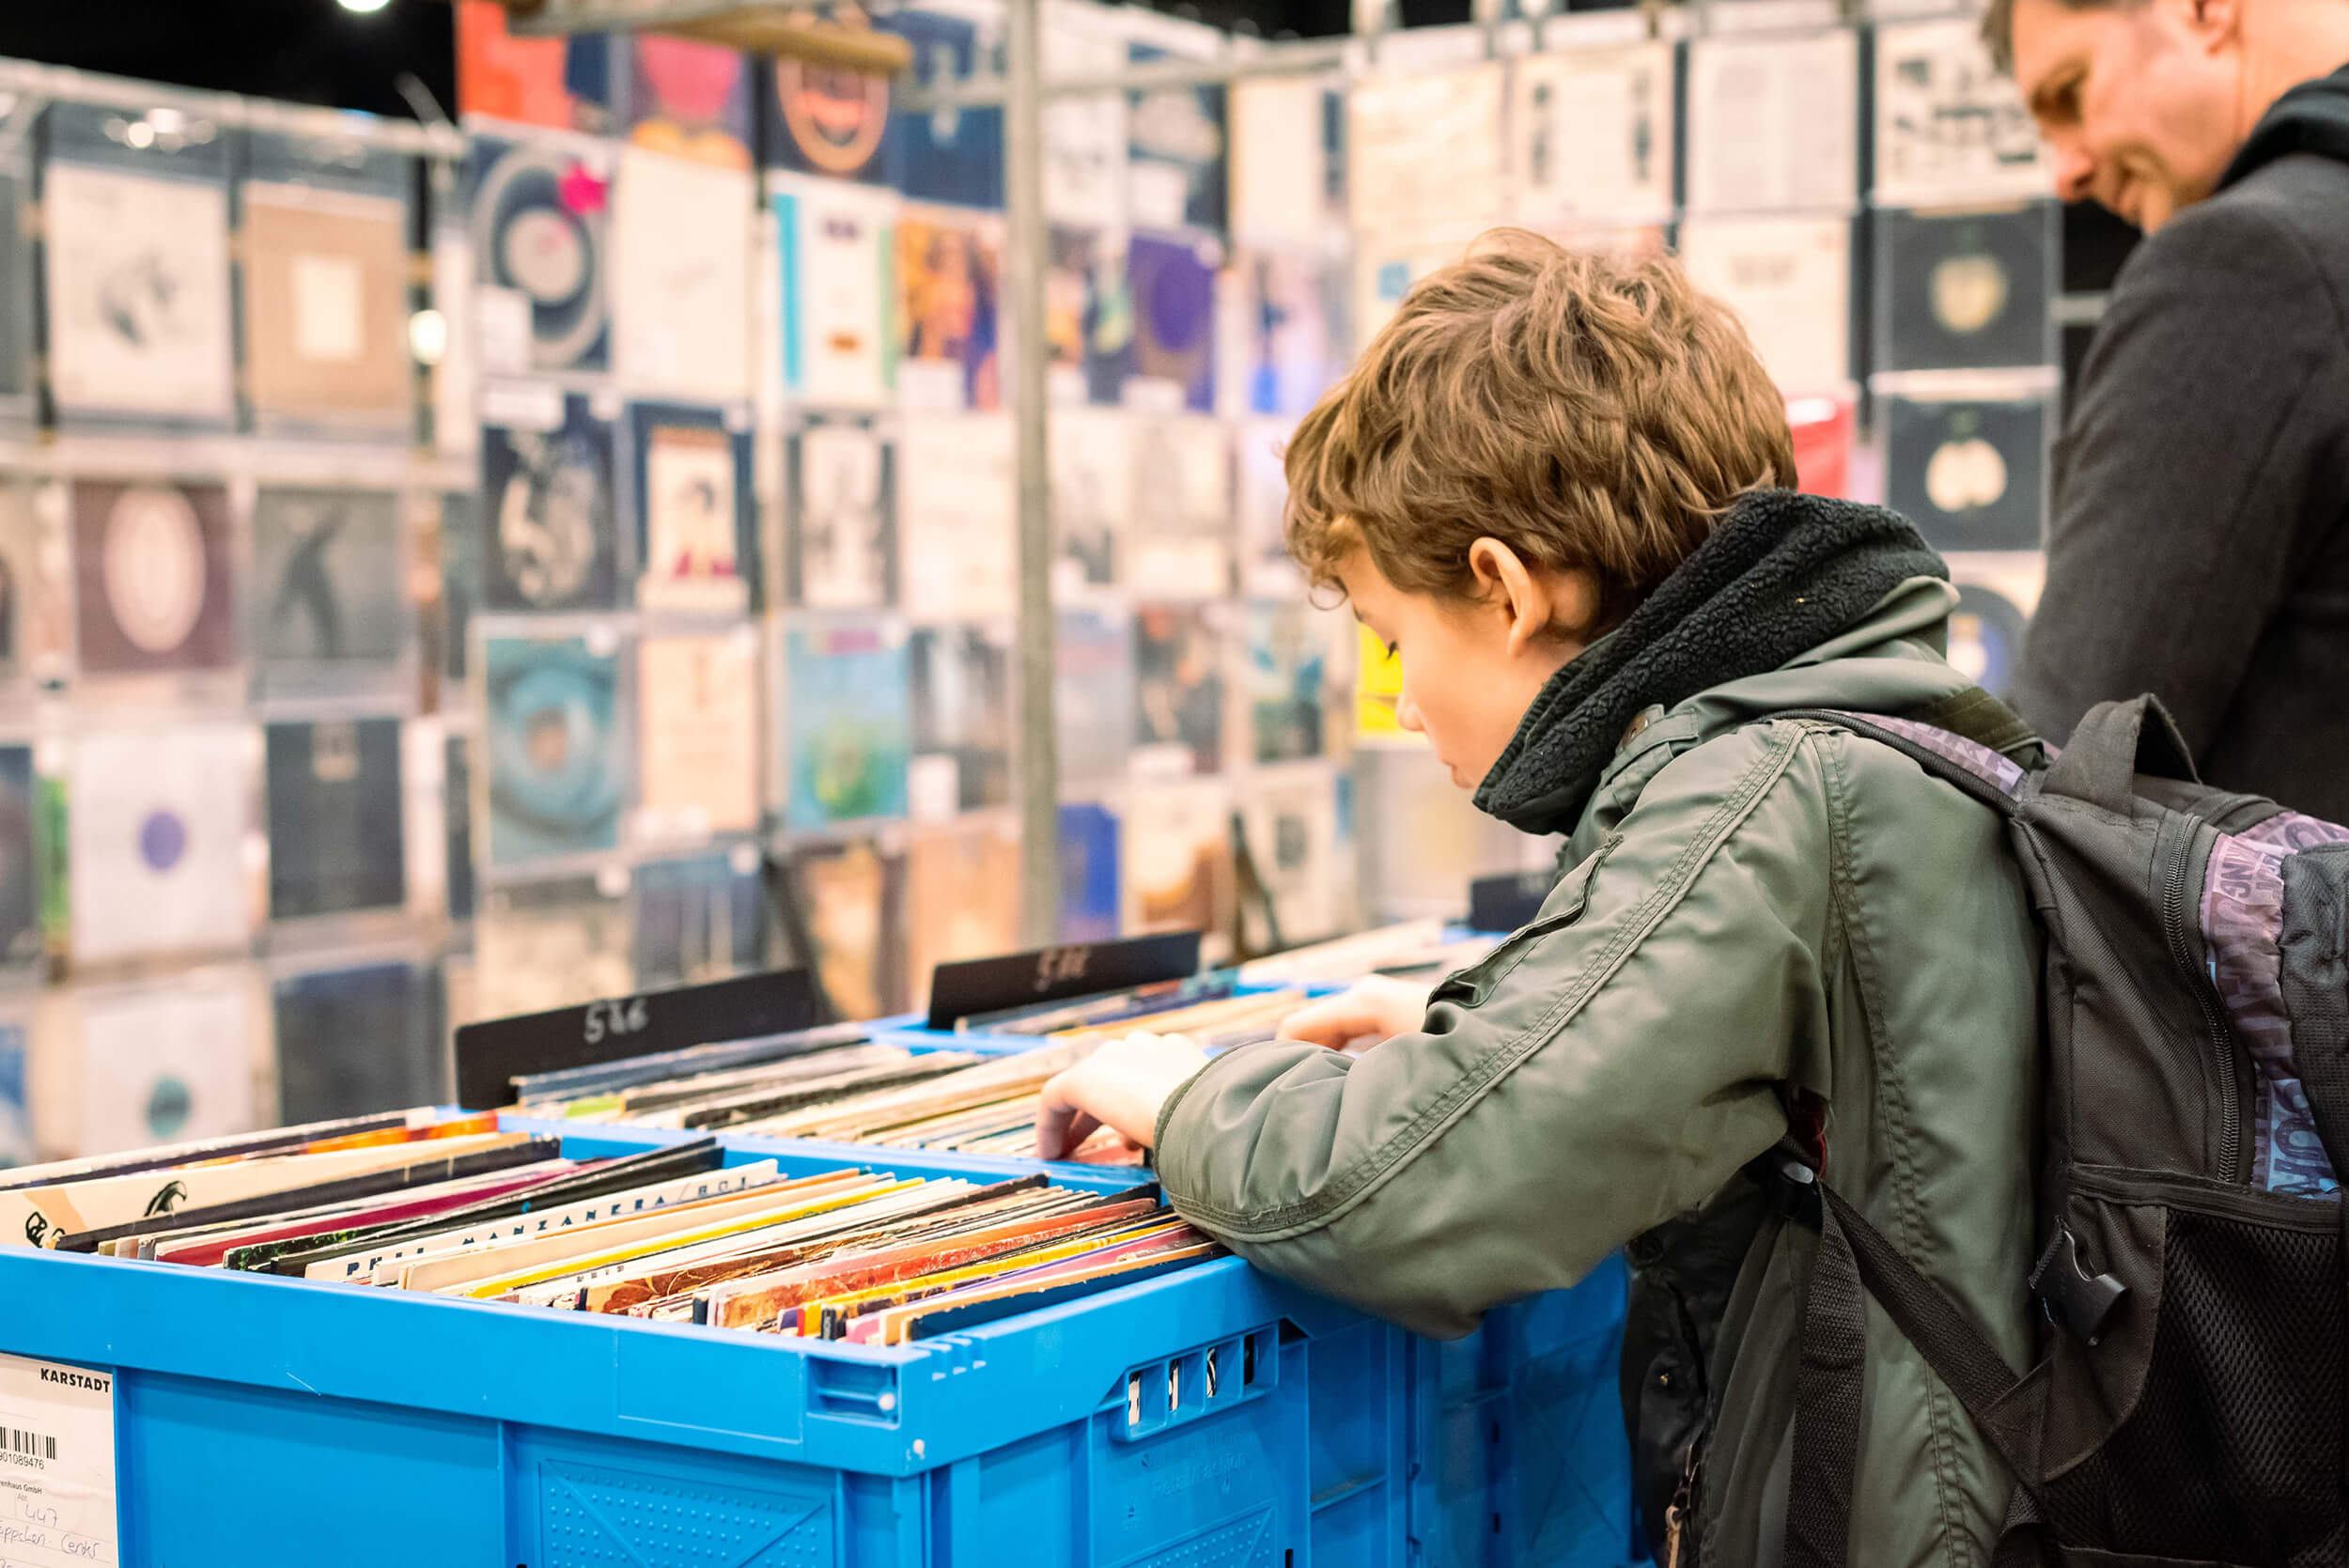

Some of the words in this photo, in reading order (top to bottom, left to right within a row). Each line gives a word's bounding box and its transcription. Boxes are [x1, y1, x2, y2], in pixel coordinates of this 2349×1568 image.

[40, 1368, 111, 1393] KARSTADT
[23, 1483, 42, 1495] GmbH
[25, 1503, 57, 1527] 447
